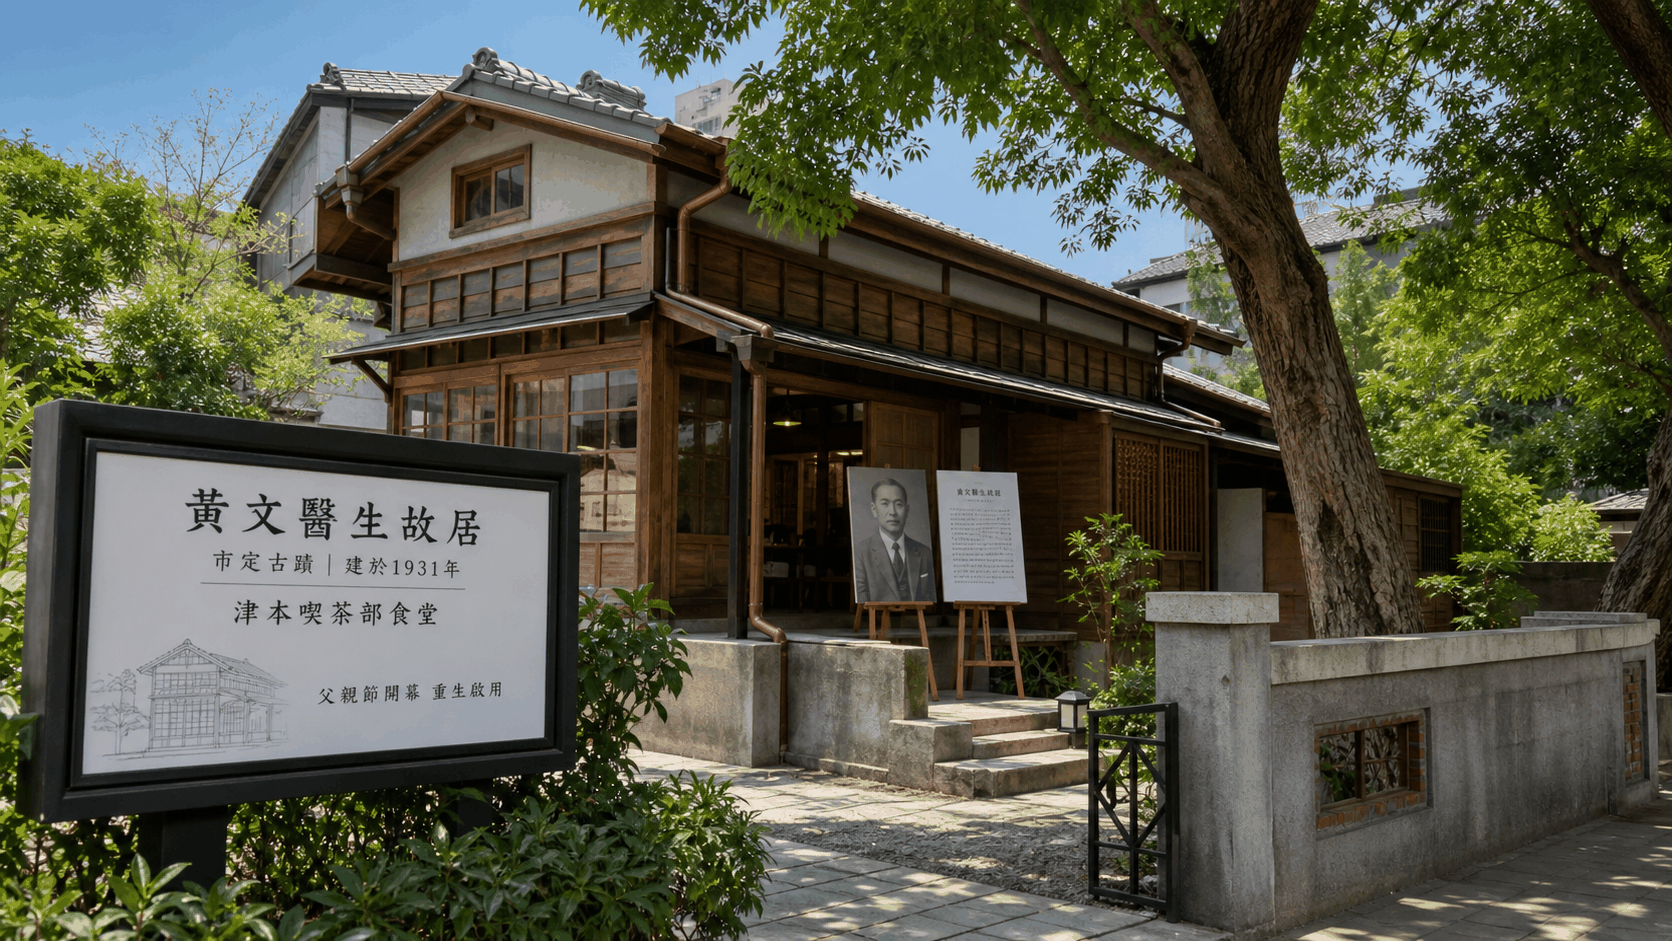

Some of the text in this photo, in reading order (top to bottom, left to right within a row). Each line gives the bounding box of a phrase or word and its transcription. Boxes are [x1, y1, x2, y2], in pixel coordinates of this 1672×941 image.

[185, 488, 481, 547] 黃文醫生故居
[213, 550, 461, 579] 市定古蹟 建於1931年
[234, 599, 438, 627] 津本喫茶部食堂
[318, 681, 502, 705] 父親節開幕 重生啟用
